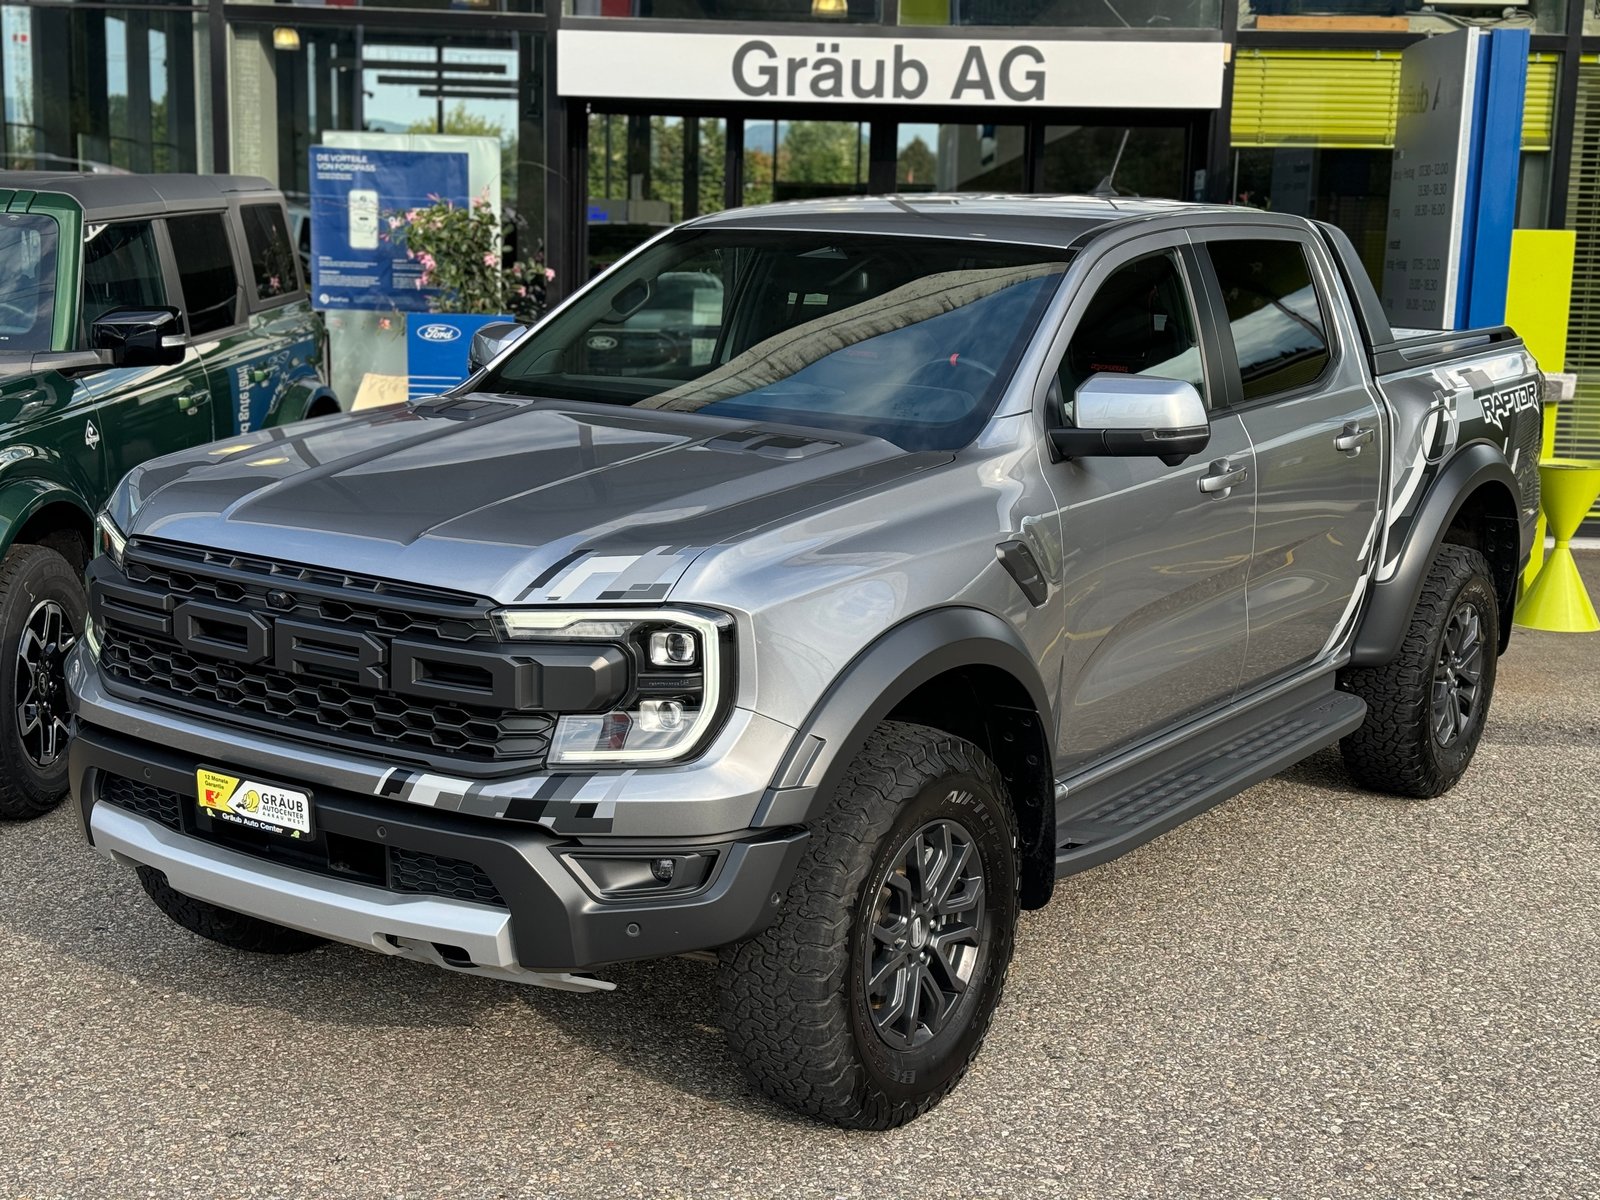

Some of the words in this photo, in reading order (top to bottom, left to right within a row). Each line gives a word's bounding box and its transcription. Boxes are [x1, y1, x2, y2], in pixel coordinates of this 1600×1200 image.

[732, 40, 929, 99] Gräub
[950, 45, 1046, 102] AG
[316, 153, 329, 162] DIE
[316, 162, 334, 171] VON
[424, 326, 454, 339] Ford
[1479, 381, 1539, 431] RAPTOR
[90, 575, 537, 710] FORD
[261, 793, 304, 812] GRÄUB
[262, 804, 304, 820] AUTOCENTER
[262, 812, 284, 821] AARAU
[287, 817, 305, 826] WEST
[222, 813, 243, 824] Gräub
[243, 818, 259, 828] Auto
[260, 822, 284, 834] Center
